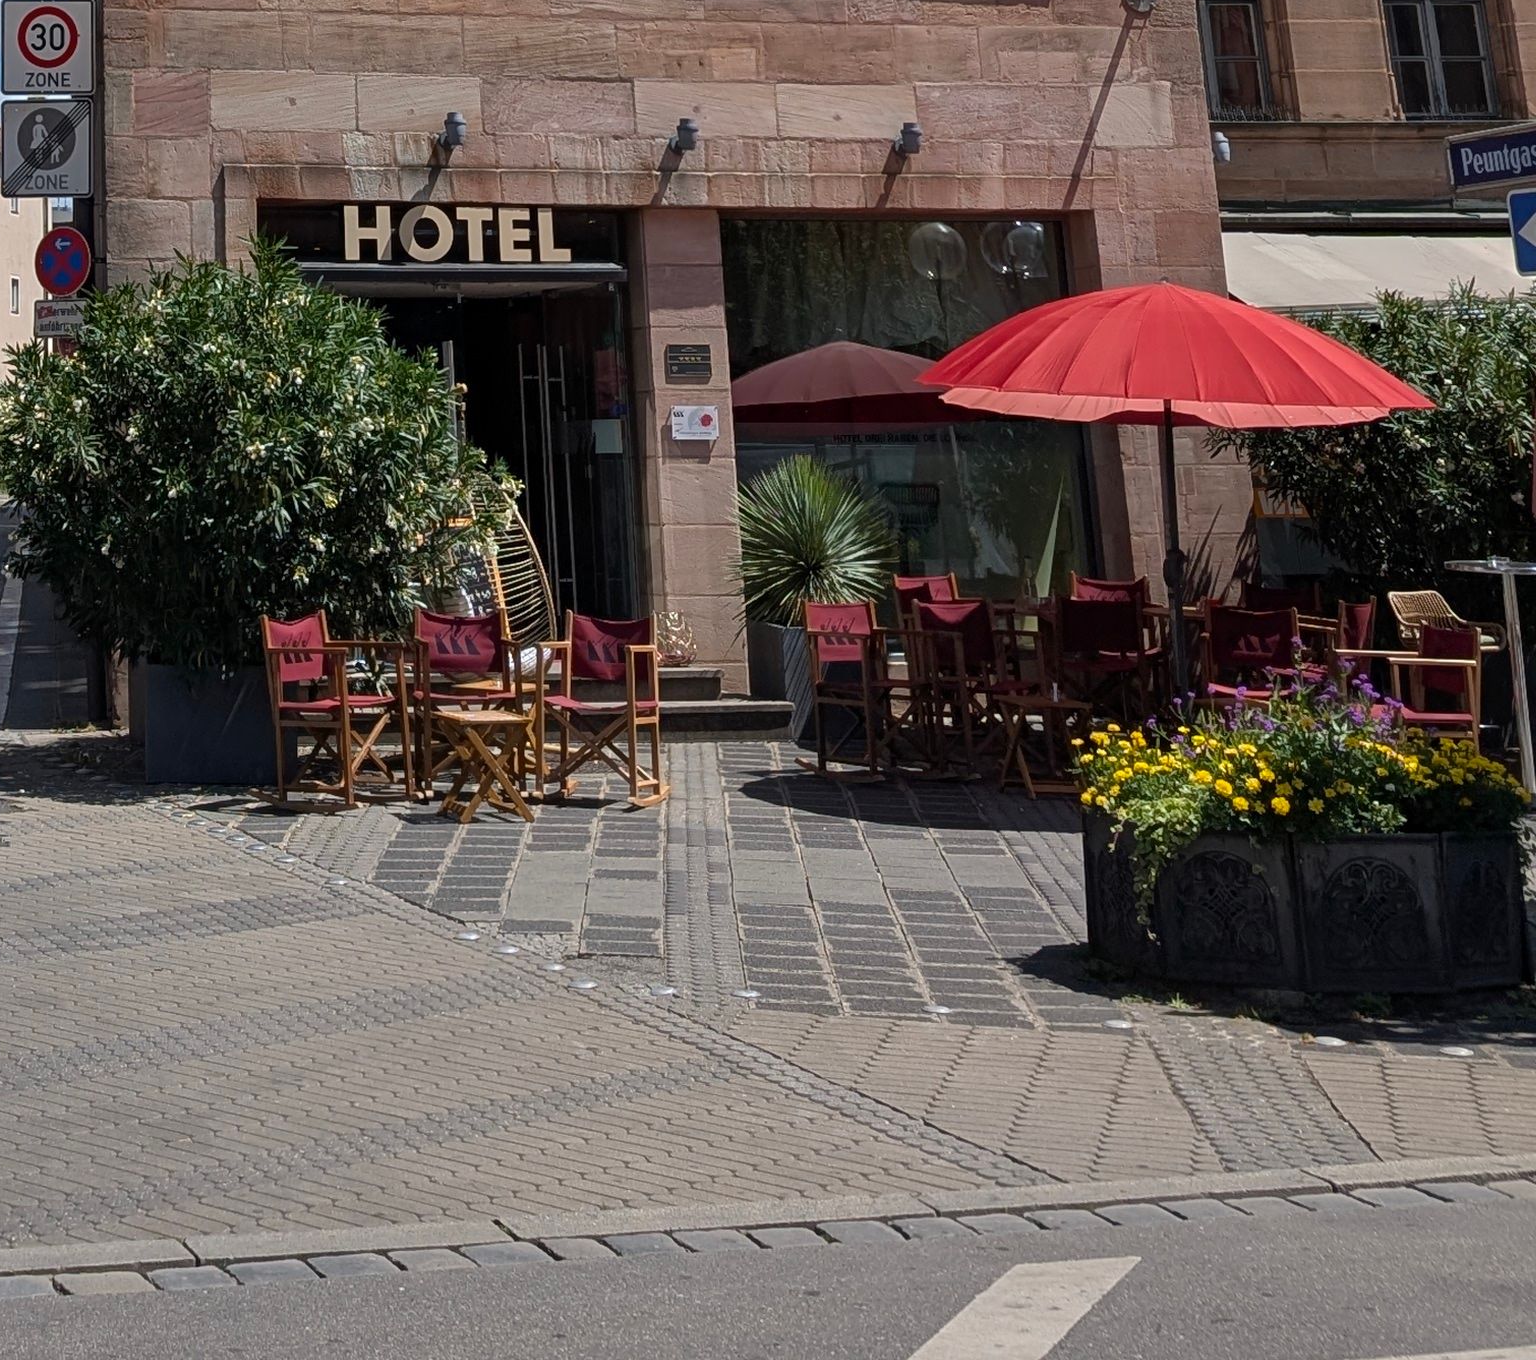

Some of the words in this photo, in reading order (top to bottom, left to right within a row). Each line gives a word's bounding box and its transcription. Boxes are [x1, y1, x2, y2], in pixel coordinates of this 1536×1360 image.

[31, 23, 64, 51] 30
[25, 72, 71, 87] ZONE
[25, 174, 69, 190] ZONE
[344, 205, 571, 262] HOTEL
